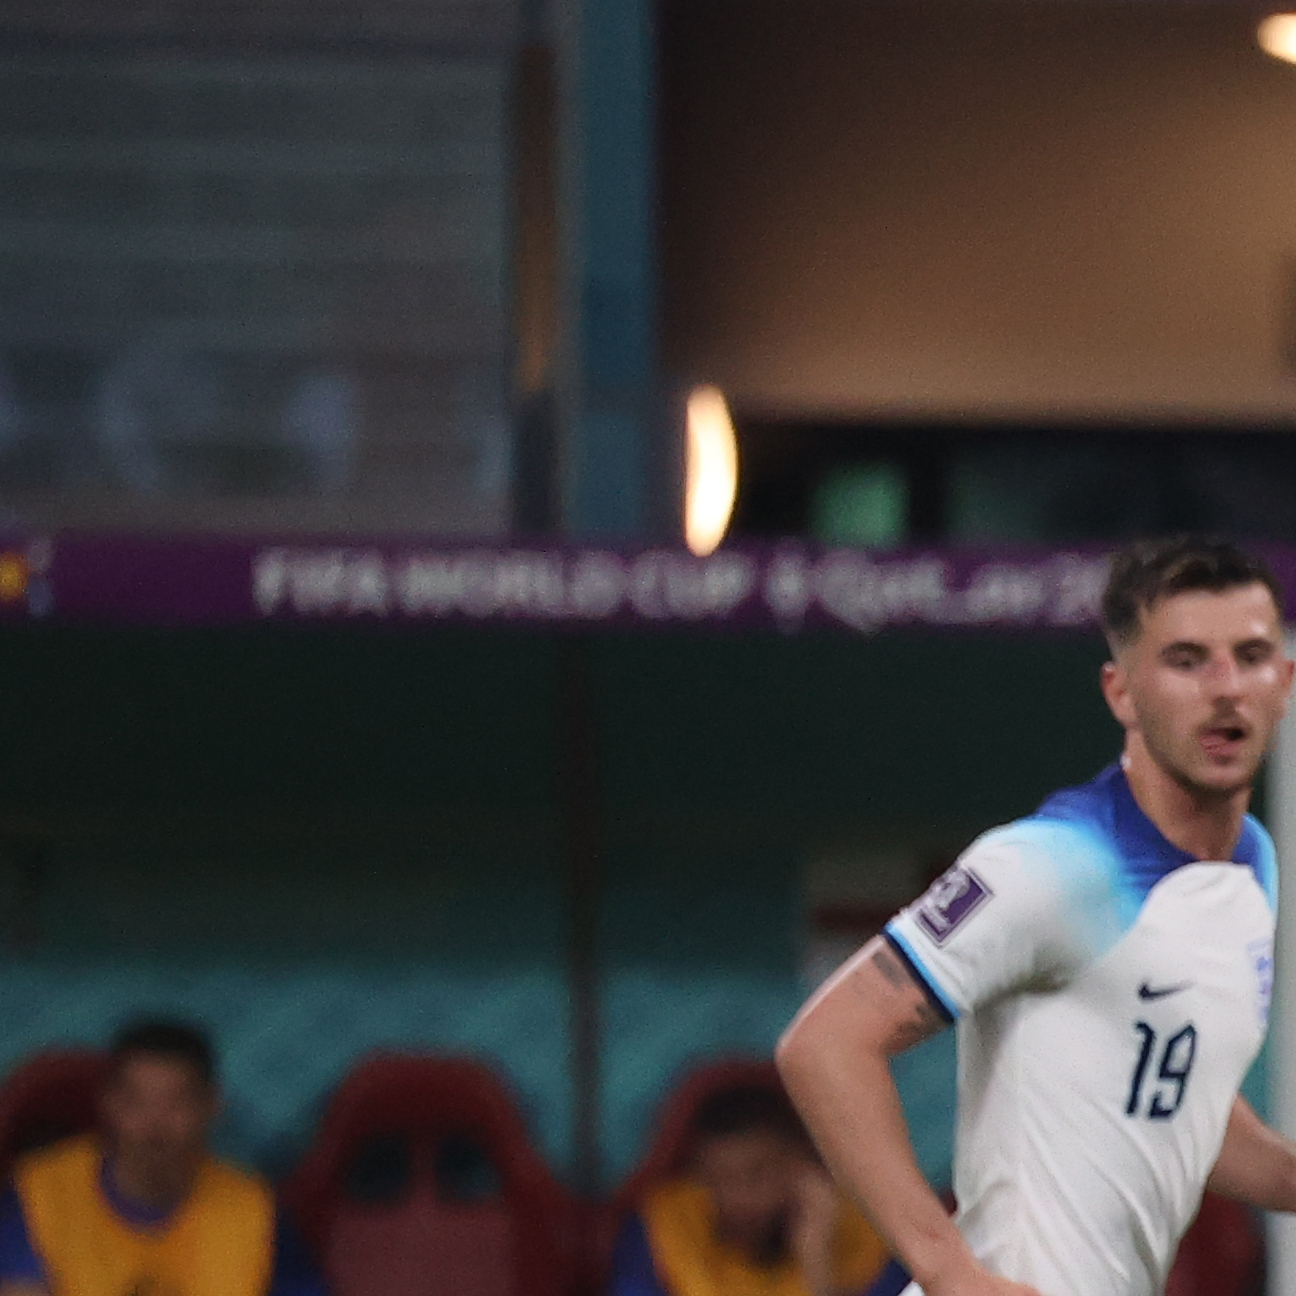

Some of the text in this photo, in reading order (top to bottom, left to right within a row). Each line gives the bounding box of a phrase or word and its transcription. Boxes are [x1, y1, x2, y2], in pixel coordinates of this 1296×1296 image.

[253, 546, 388, 616] FIFA
[396, 547, 628, 617] WORLD
[631, 548, 748, 618] CUP
[1126, 1020, 1198, 1121] 19
